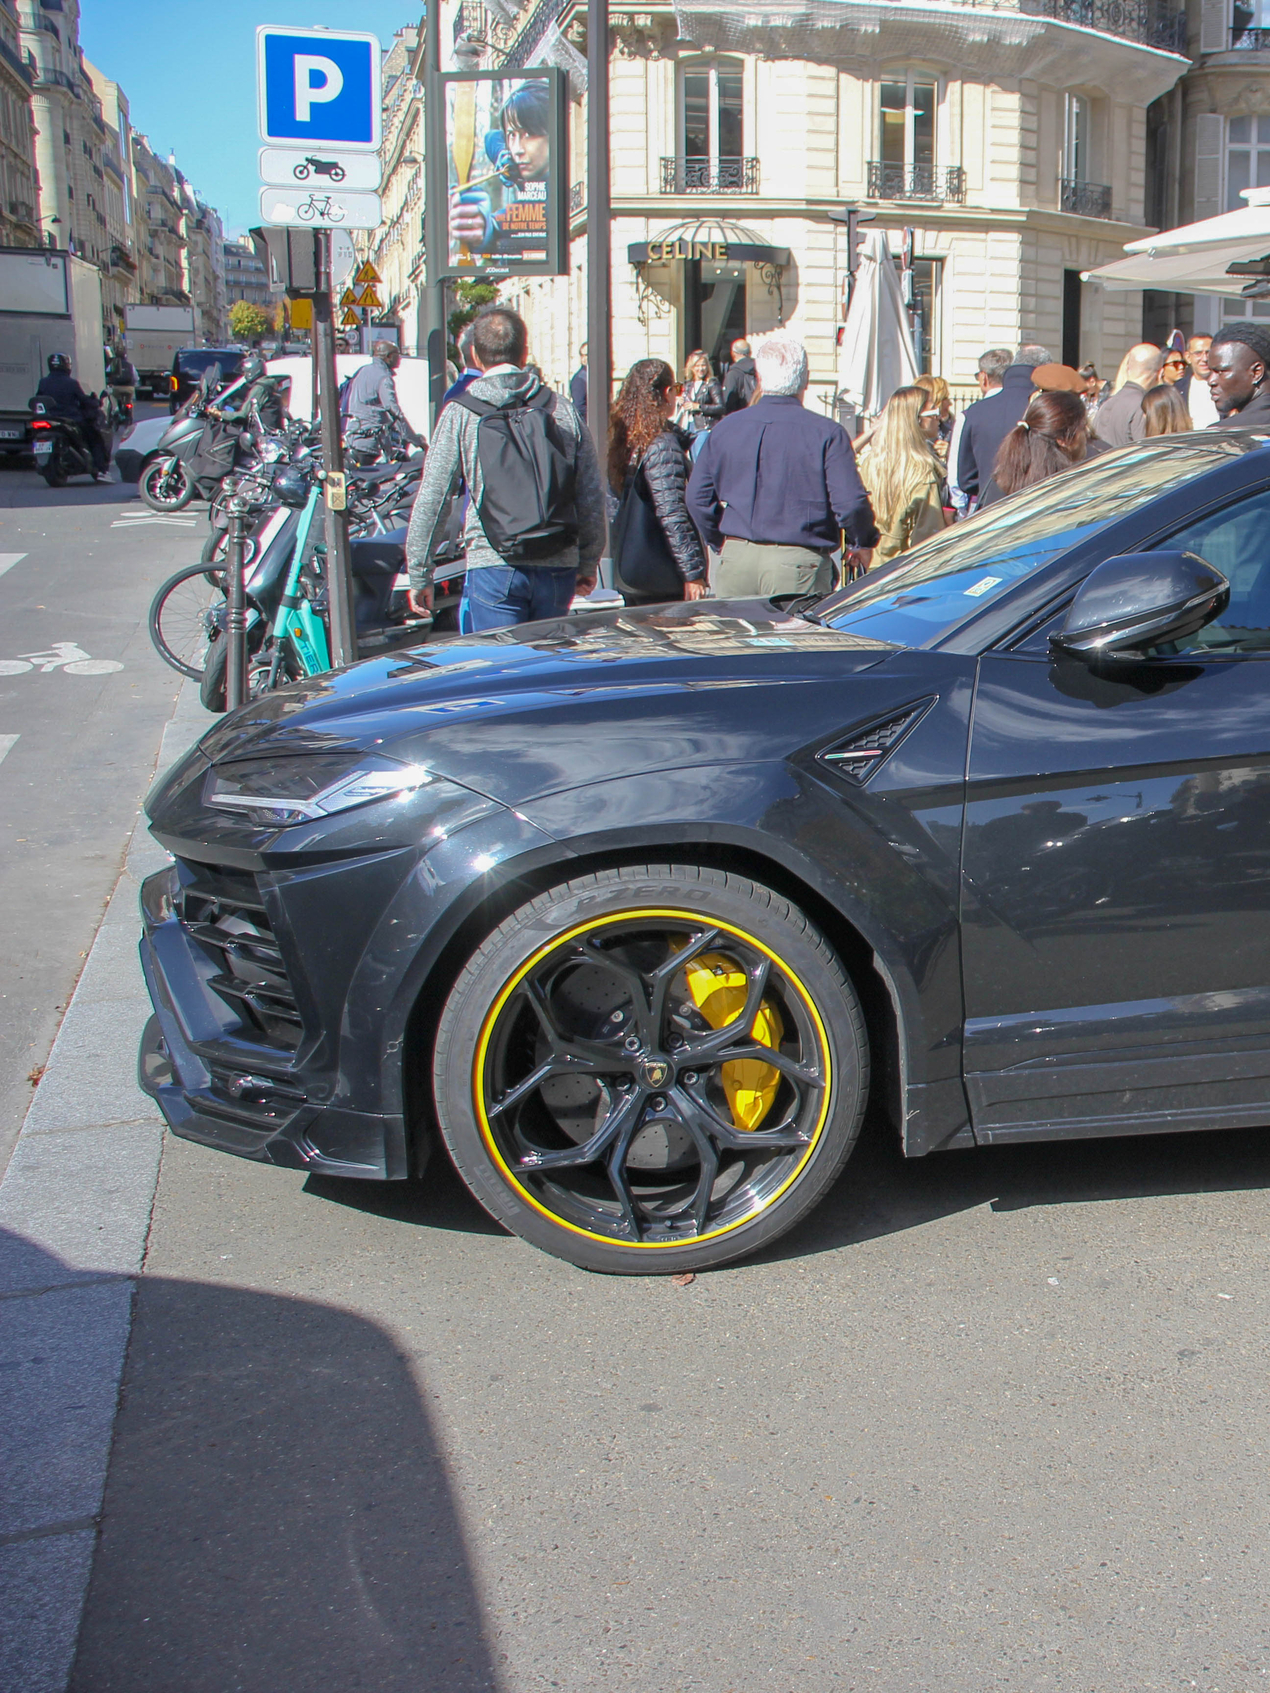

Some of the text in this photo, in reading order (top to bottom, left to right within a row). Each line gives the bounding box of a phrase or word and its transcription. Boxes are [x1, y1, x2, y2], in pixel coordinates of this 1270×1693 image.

[293, 53, 344, 122] P
[518, 191, 546, 200] MARCEAU
[525, 182, 546, 191] SOPHIE
[506, 204, 546, 221] FEMME
[647, 240, 728, 260] CELINE
[312, 555, 321, 574] TIER
[300, 642, 320, 675] TIER
[609, 885, 712, 901] ZERO
